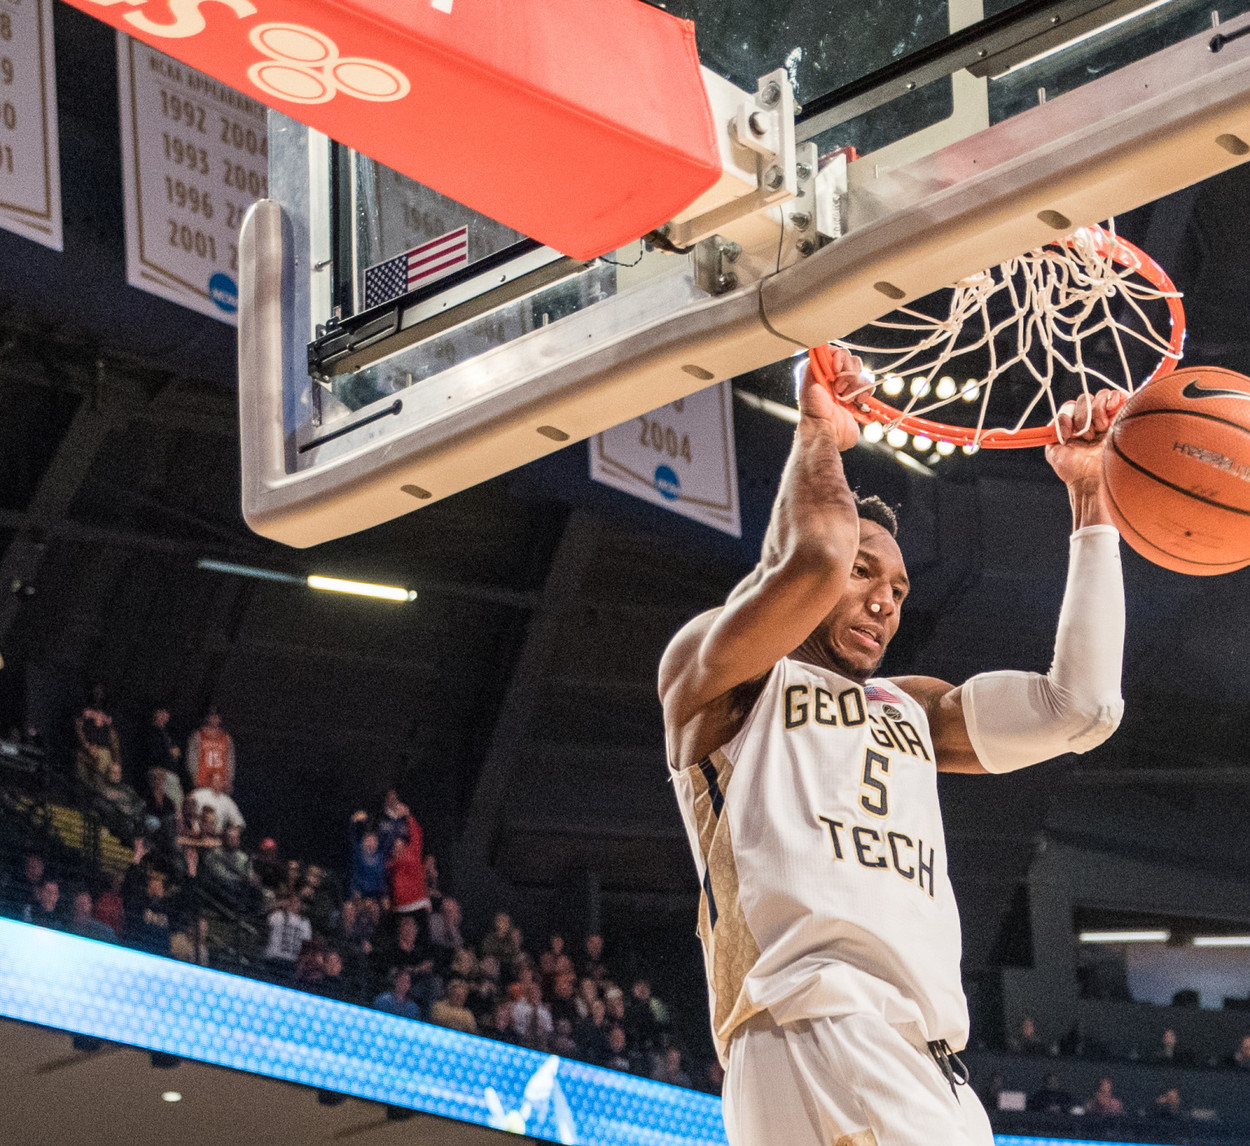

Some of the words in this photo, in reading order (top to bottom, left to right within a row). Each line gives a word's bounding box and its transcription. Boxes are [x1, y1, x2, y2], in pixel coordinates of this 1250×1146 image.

[161, 89, 207, 134] 1992
[163, 131, 210, 176] 1993
[164, 174, 214, 219] 1996
[168, 218, 216, 262] 2001
[639, 416, 692, 464] 2004
[784, 683, 932, 763] GEOGIA
[859, 746, 891, 820] 5
[818, 814, 936, 899] TECH
